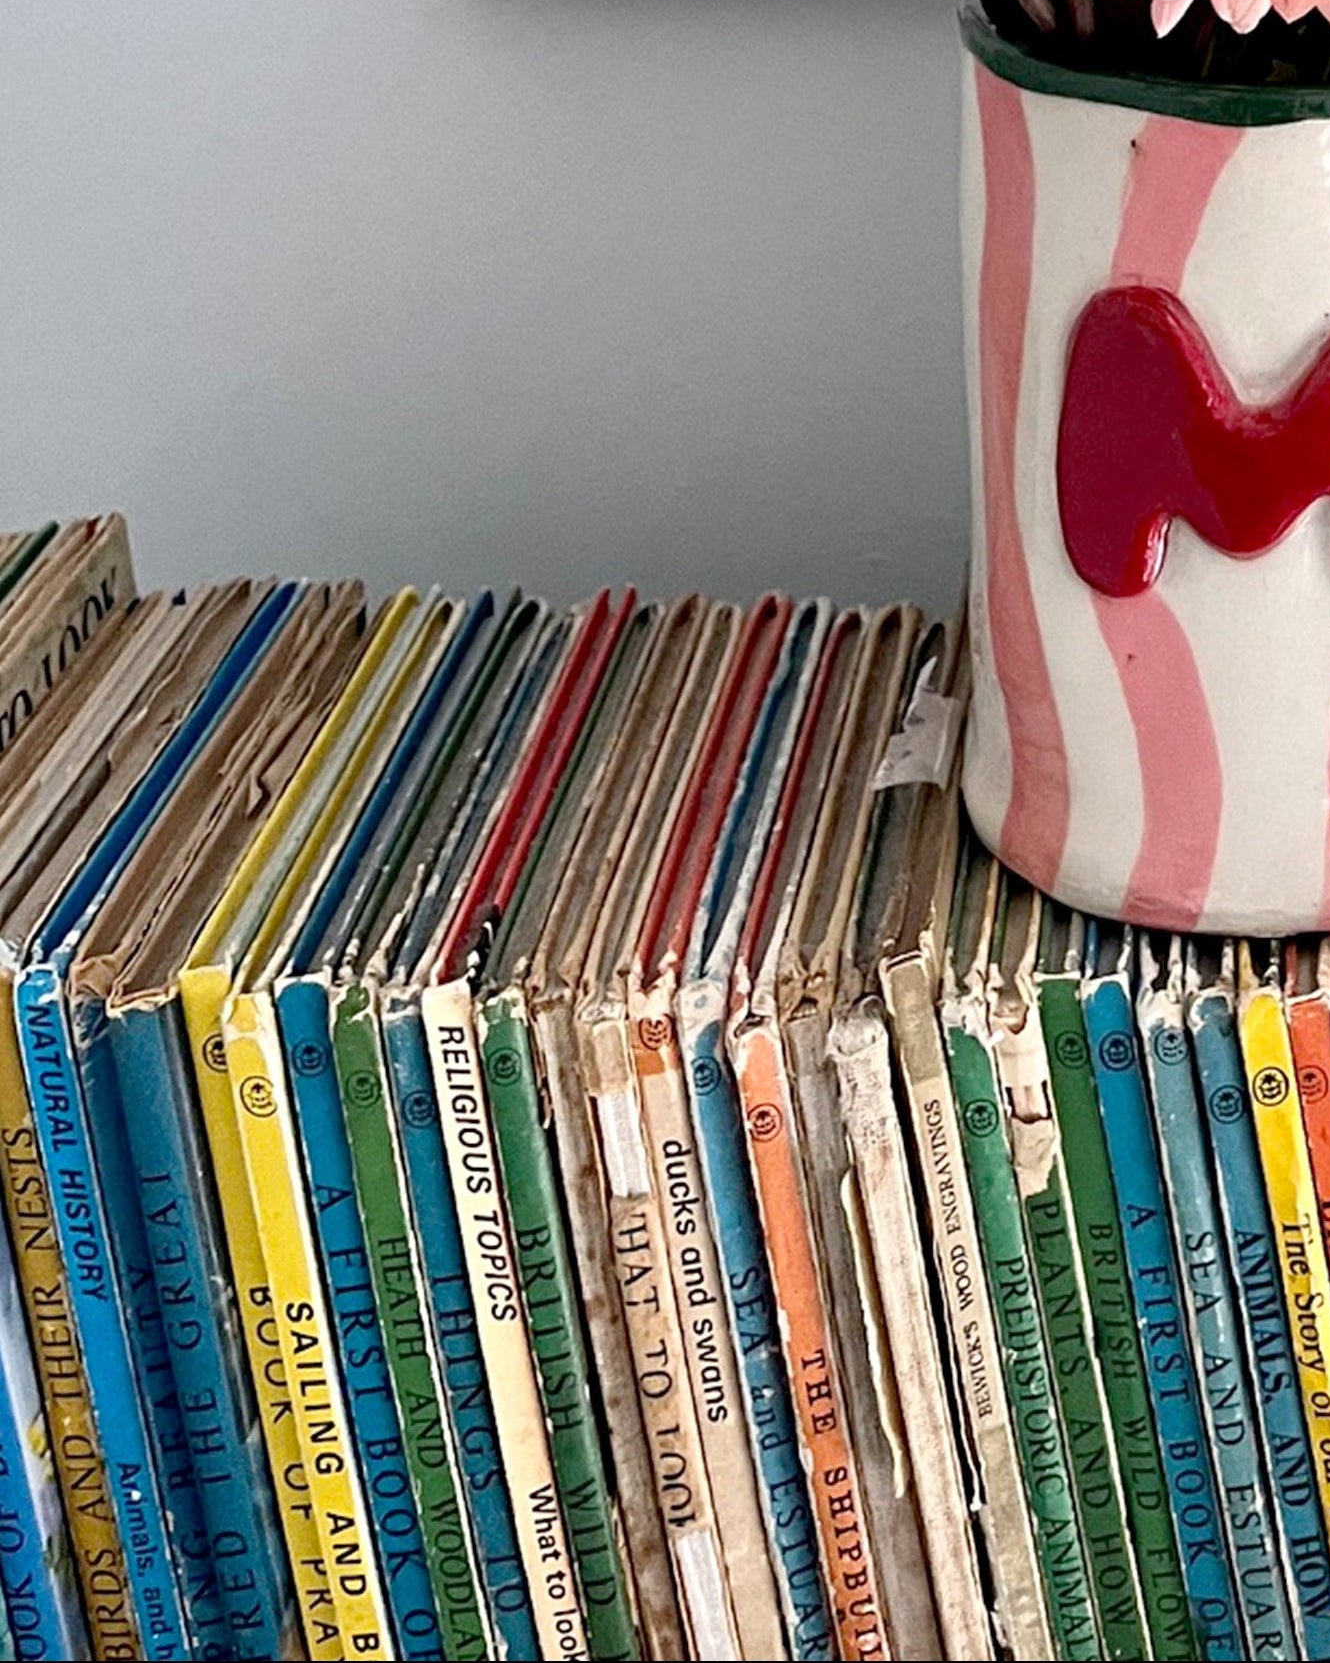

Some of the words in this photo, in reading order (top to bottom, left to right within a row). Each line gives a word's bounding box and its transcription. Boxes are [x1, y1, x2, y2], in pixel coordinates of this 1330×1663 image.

[5, 1127, 57, 1252] NESTS
[26, 1005, 78, 1153] NATURAL
[59, 1168, 108, 1303] HISTORY
[316, 1184, 352, 1213] A
[663, 1140, 701, 1236] ducks
[924, 1099, 963, 1236] ENGRAVINGS
[142, 1172, 203, 1351] GREAT
[1127, 1204, 1159, 1229] A
[1281, 1213, 1315, 1277] The
[329, 1248, 391, 1400] FIRST
[438, 1025, 493, 1195] RELIGIOUS
[472, 1210, 517, 1322] TOPICS
[528, 1483, 561, 1564] What
[546, 1572, 567, 1601] to
[680, 1247, 717, 1308] and
[730, 1266, 775, 1358] SEA
[950, 1243, 976, 1312] WOOD
[1184, 1231, 1224, 1316] SEA
[33, 1287, 83, 1401] THEIR
[378, 1236, 424, 1361] HEATH
[404, 1390, 446, 1470] AND
[639, 1339, 672, 1400] TO
[693, 1319, 729, 1423] swans
[963, 1320, 993, 1419] BEWICK'S
[995, 1256, 1066, 1497] PREHISTORIC
[1088, 1224, 1137, 1380] BRITISH
[1121, 1415, 1161, 1512] WILD
[1138, 1266, 1190, 1403] FIRST
[1295, 1291, 1327, 1373] Story
[185, 1389, 231, 1484] THE
[516, 1225, 583, 1431] BRITISH
[565, 1477, 617, 1606] WILD
[752, 1384, 792, 1454] and
[802, 1349, 838, 1436] THE
[1203, 1353, 1245, 1447] AND
[63, 1435, 116, 1523] AND
[286, 1302, 344, 1476] SAILING
[327, 1512, 367, 1597] AND
[352, 1633, 380, 1653] B
[433, 1274, 500, 1492] THINGS
[486, 1554, 527, 1614] TO
[1271, 1434, 1312, 1507] AND
[365, 1438, 426, 1578] BOOK
[1067, 1418, 1112, 1510] AND
[1090, 1534, 1136, 1626] HOW
[1168, 1440, 1218, 1566] BOOK
[86, 1548, 140, 1661] BIRDS
[144, 1588, 174, 1641] and
[1200, 1598, 1235, 1652] OF
